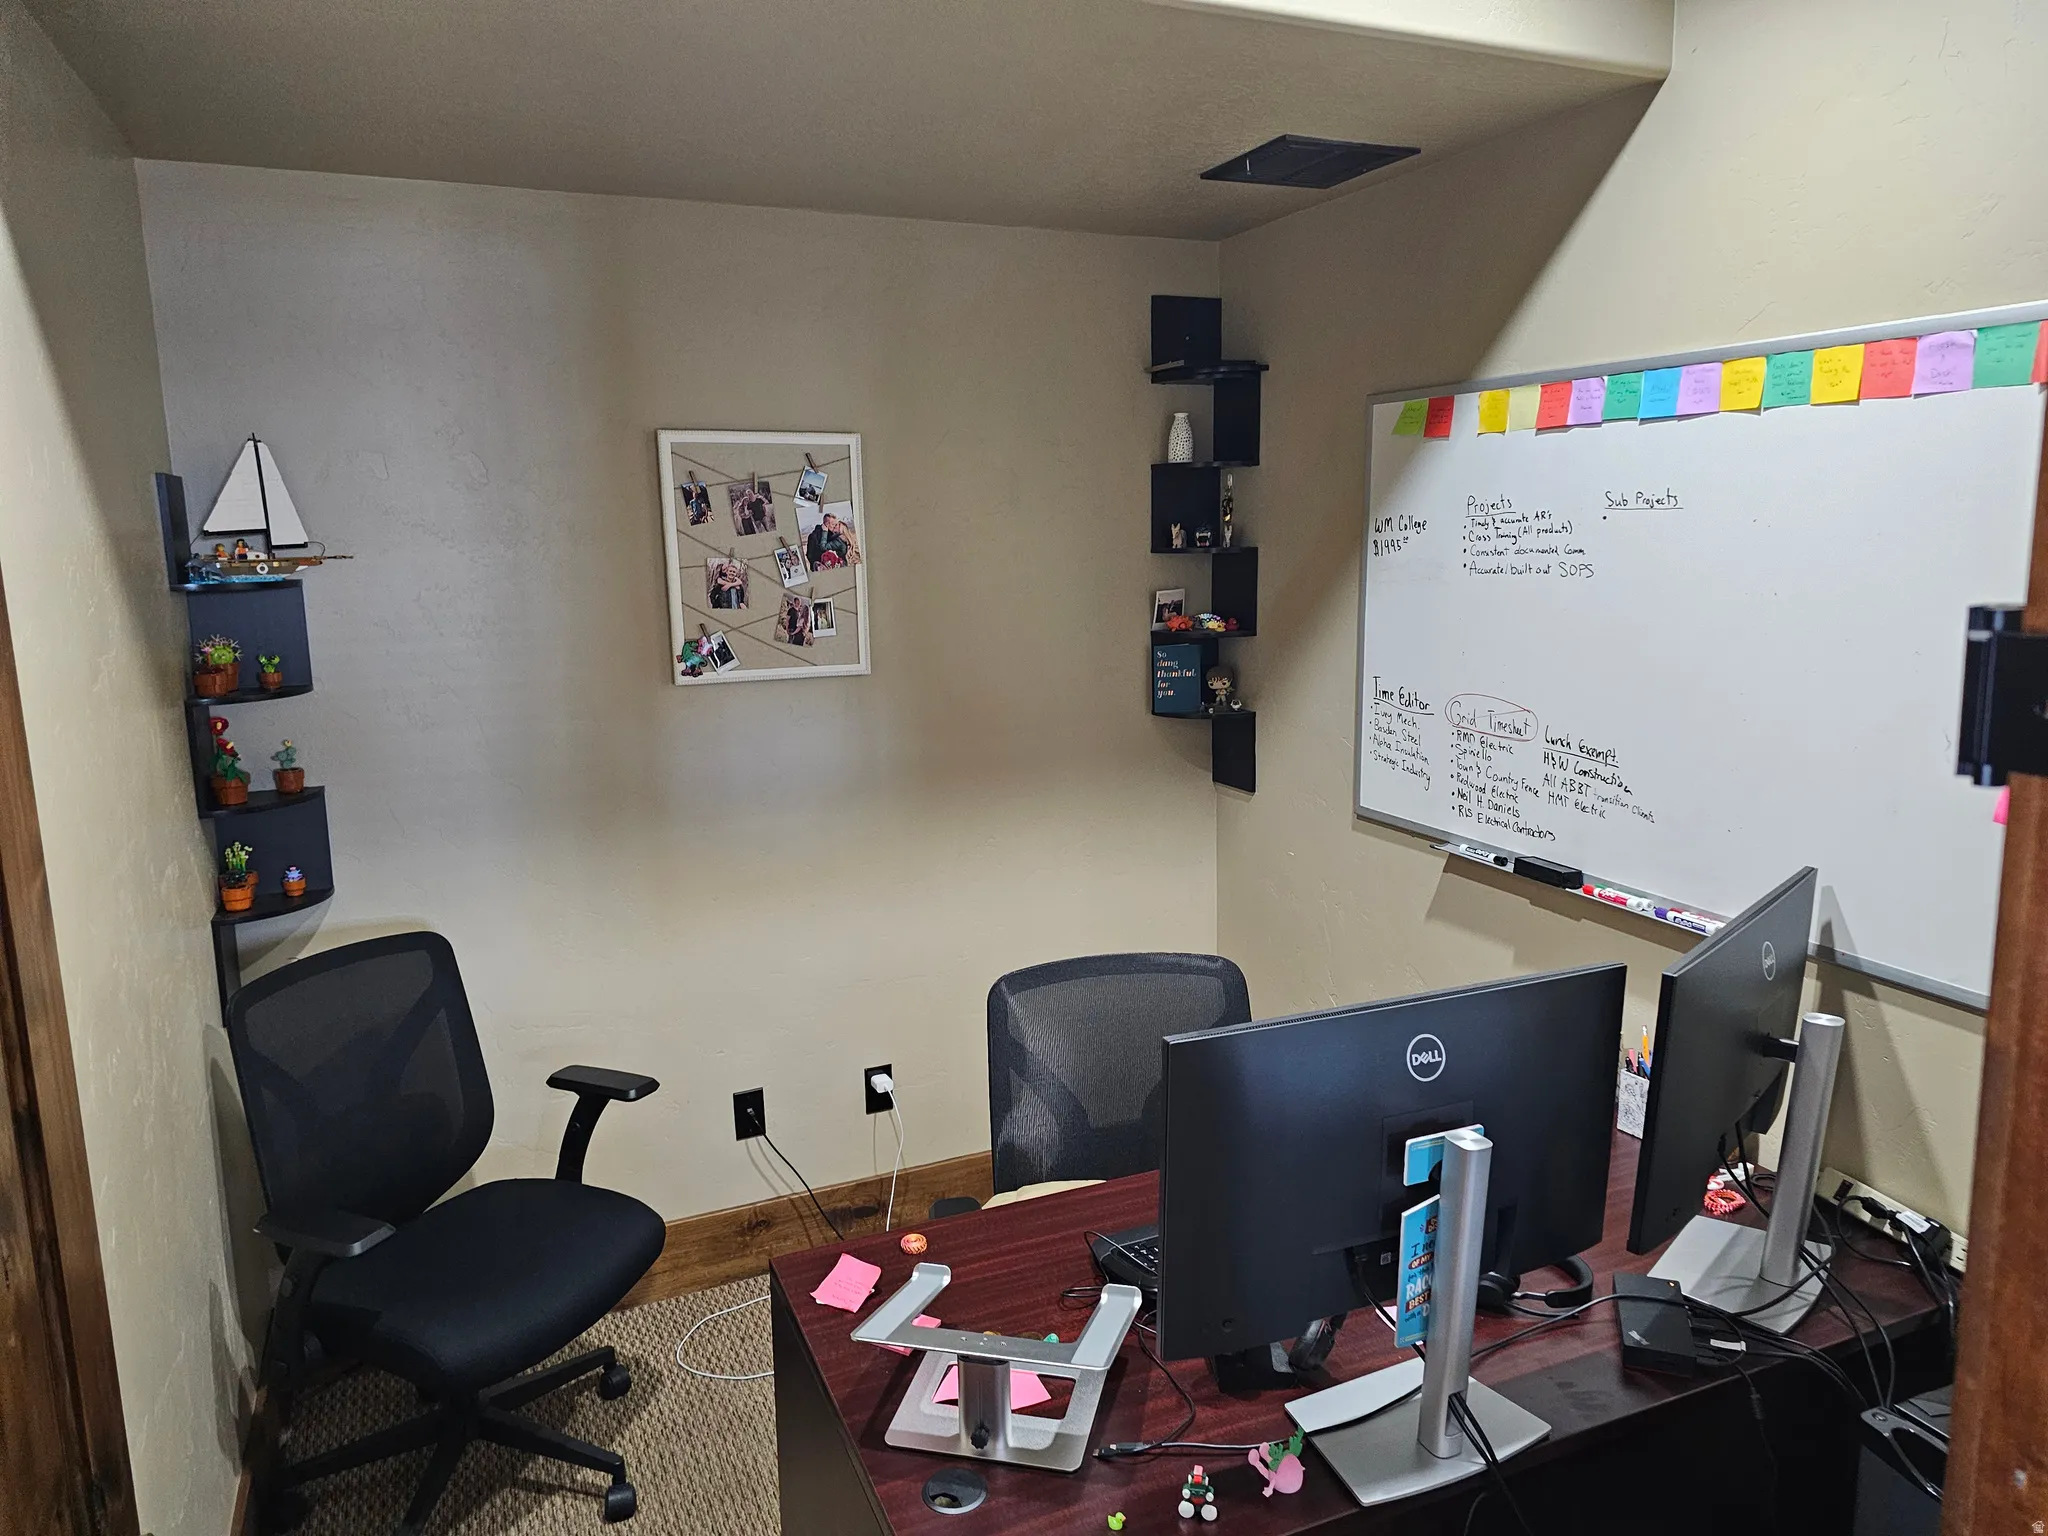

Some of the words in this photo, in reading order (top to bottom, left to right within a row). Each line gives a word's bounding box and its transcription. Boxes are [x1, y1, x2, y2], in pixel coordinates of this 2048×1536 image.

[1467, 494, 1512, 515] Projects
[1605, 490, 1628, 507] Sub
[1636, 487, 1678, 509] Projects
[1398, 514, 1427, 535] College
[1500, 512, 1529, 524] accurate
[1468, 530, 1491, 543] Cross
[1494, 526, 1518, 545] Training
[1469, 543, 1510, 557] Consistent
[1514, 544, 1560, 556] documented
[1535, 563, 1552, 575] out
[1558, 561, 1595, 579] SOPS
[1156, 651, 1167, 659] So
[1156, 659, 1179, 669] dang
[1156, 669, 1197, 678] thankful
[1157, 680, 1171, 689] for
[1373, 676, 1394, 701] Time
[1399, 686, 1430, 710] Editor
[1450, 700, 1477, 727] Grid
[1487, 709, 1532, 737] Timesheet
[1401, 728, 1421, 747] Steel
[1545, 725, 1572, 750] Lunch
[1395, 740, 1430, 765] Insulation
[1373, 749, 1400, 770] Strategic
[1401, 759, 1431, 791] Industry
[1455, 754, 1474, 772] Town
[1485, 765, 1519, 791] Country
[1521, 777, 1540, 798] Fence
[1574, 760, 1633, 796] Construction
[1456, 772, 1487, 795] Redwood
[1542, 773, 1557, 788] All
[1457, 787, 1471, 804] Neil
[1487, 799, 1521, 818] Daniels
[1548, 790, 1570, 808] HMT
[1477, 812, 1511, 830] Electrical
[1511, 820, 1556, 841] Contractors
[1411, 1049, 1442, 1067] DELL
[1411, 1242, 1420, 1258] I
[1408, 1291, 1429, 1310] BEST
